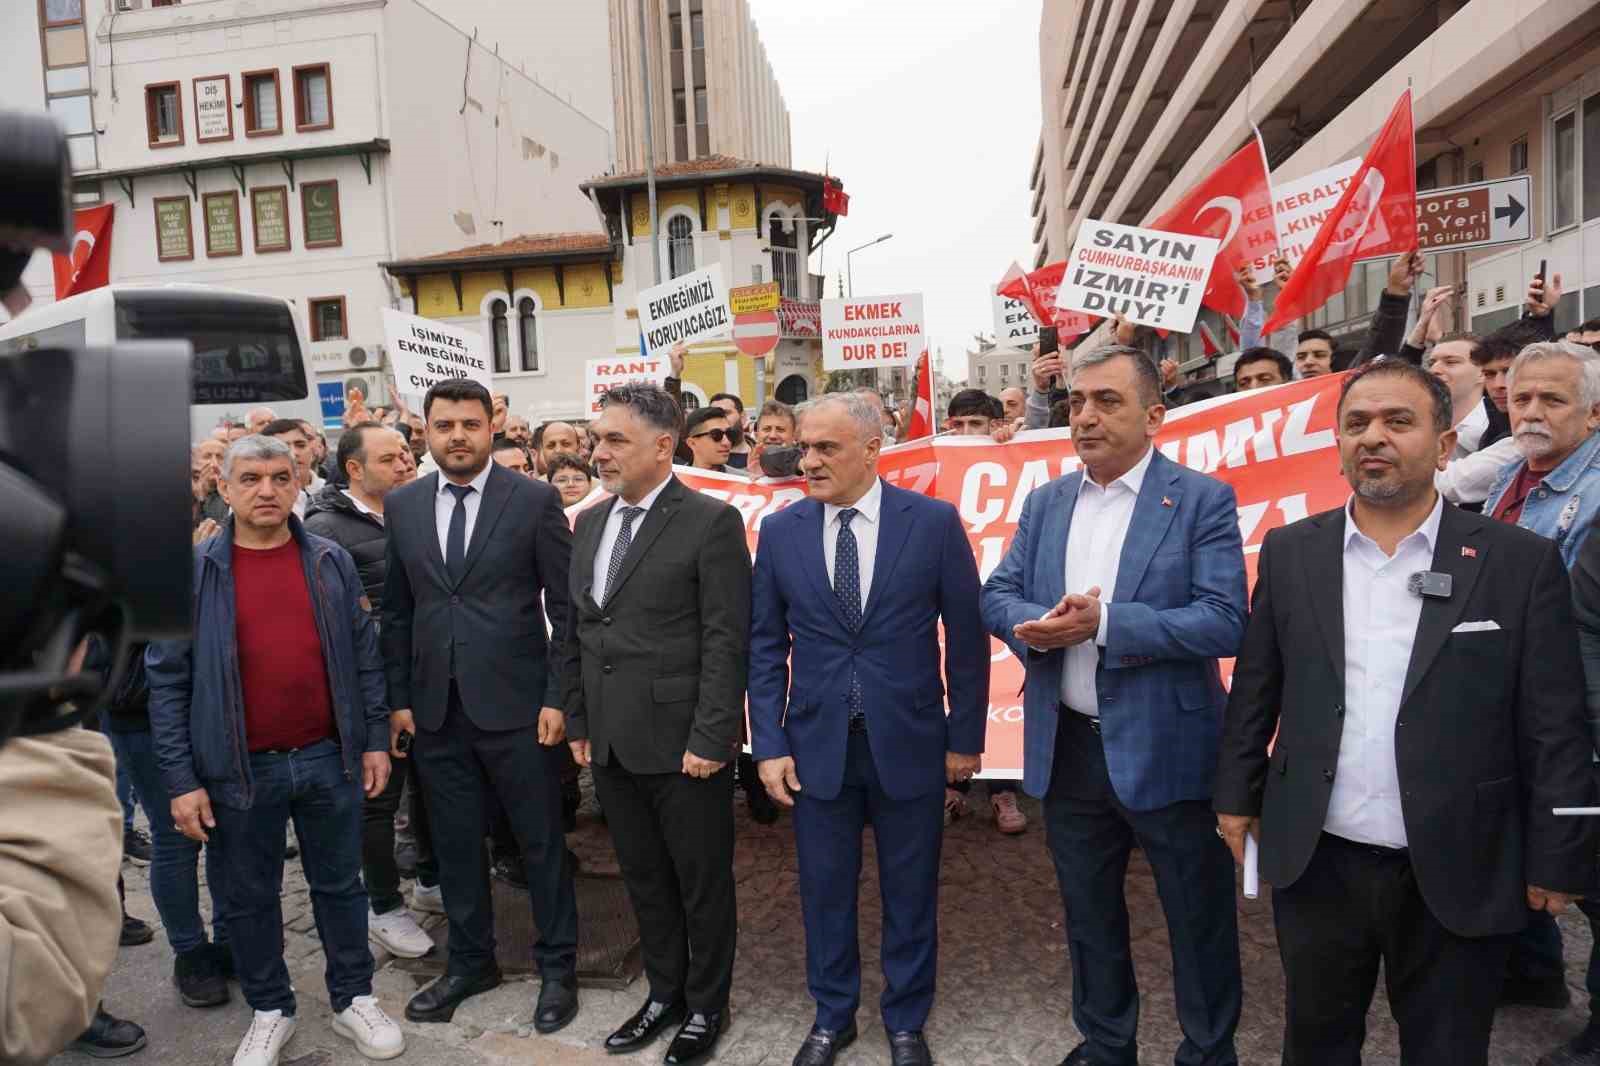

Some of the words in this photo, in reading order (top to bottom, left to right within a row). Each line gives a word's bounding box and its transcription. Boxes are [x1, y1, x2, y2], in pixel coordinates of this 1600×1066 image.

[1242, 176, 1353, 225] KEMERALT
[1438, 211, 1487, 229] Yeri
[1093, 229, 1196, 261] SAYIN
[1078, 248, 1205, 281] CUMHURBAŞKANIM
[649, 274, 714, 320] EKMEĞİMİZİ
[1073, 264, 1191, 305] İZMİR'İ
[844, 302, 902, 320] EKMEK
[1082, 291, 1166, 323] DUY!
[411, 324, 468, 352] İŞİMİZE,
[647, 304, 728, 351] KORUYACAĞIZ!
[828, 323, 920, 339] KUNDAKCILARINA
[398, 339, 486, 370] EKMEĞİMİZE
[843, 344, 876, 360] DUR
[882, 342, 908, 358] DE!
[409, 375, 438, 389] ÇIK
[426, 362, 468, 379] SAHİP
[597, 362, 661, 376] RANT
[193, 387, 255, 399] SUZU
